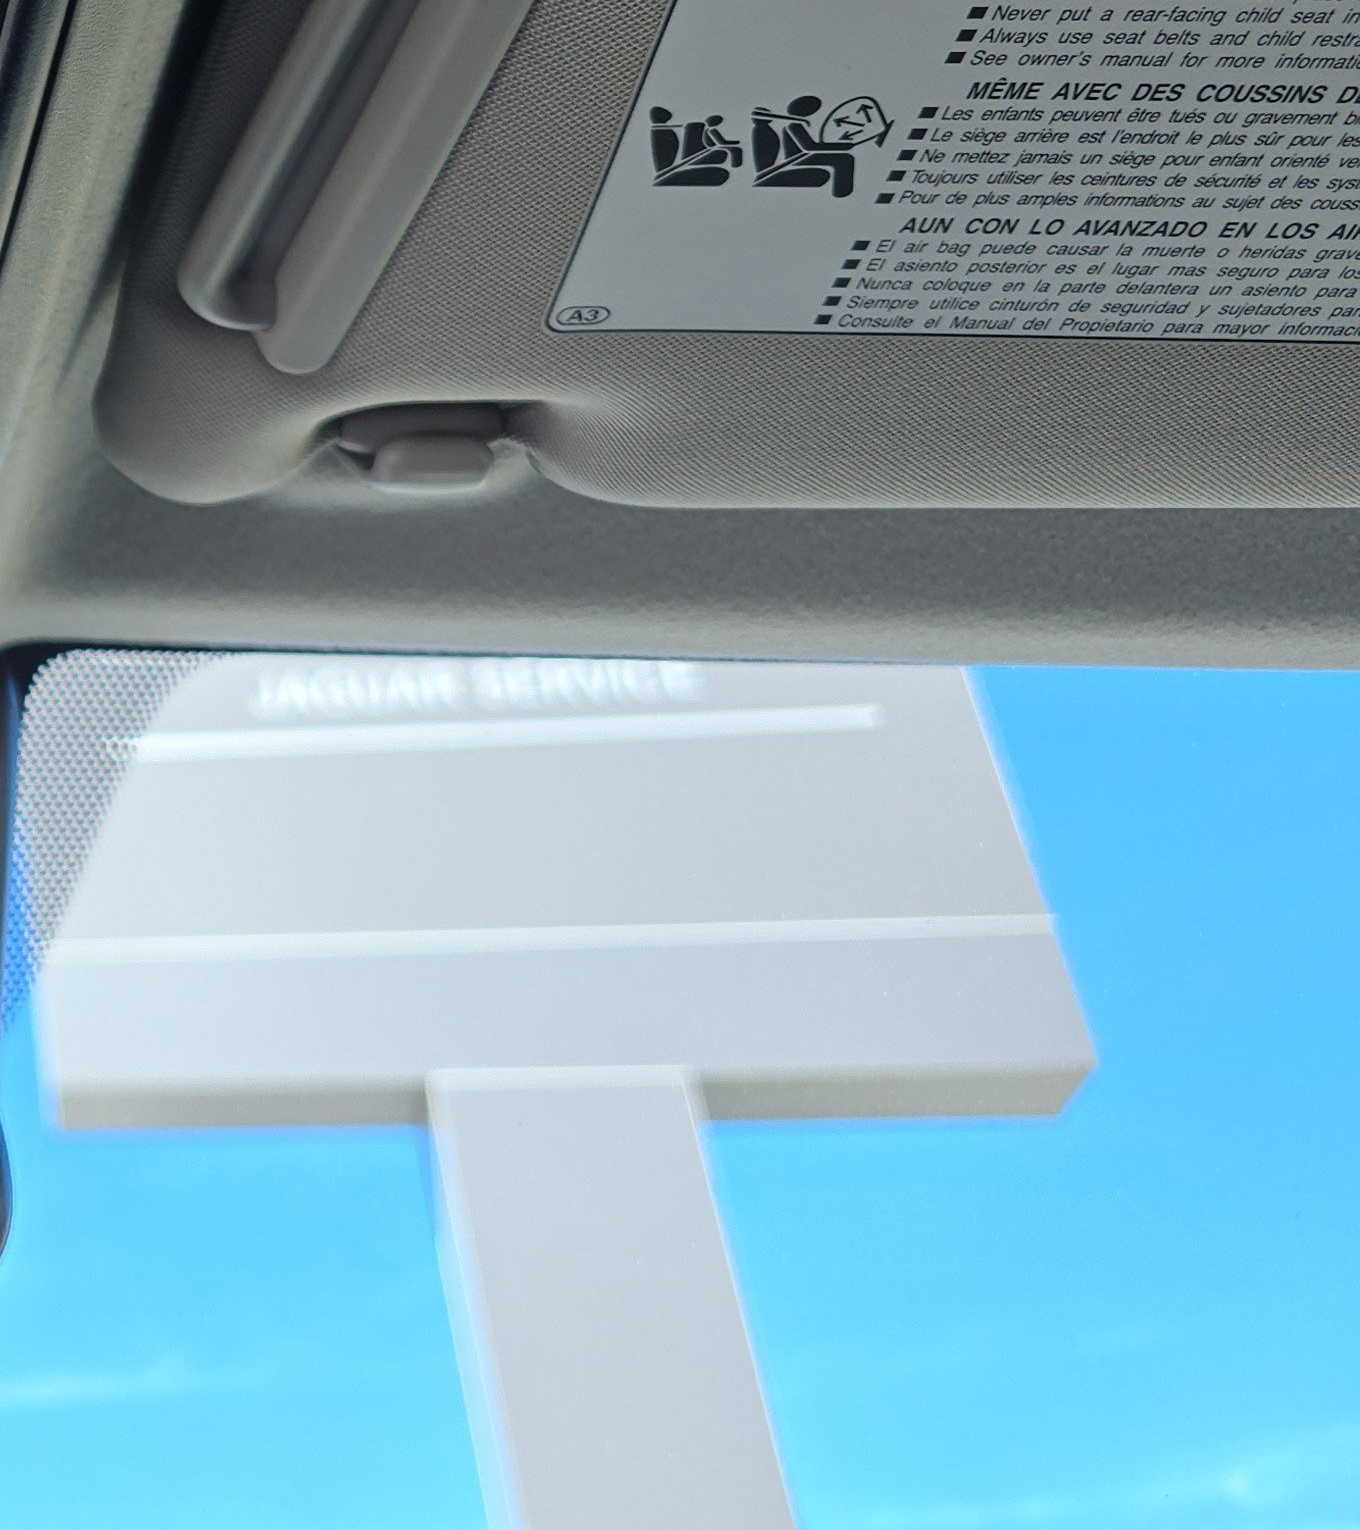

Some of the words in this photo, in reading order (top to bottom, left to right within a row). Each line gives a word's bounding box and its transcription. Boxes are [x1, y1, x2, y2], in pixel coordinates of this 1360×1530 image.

[992, 5, 1051, 21] Never
[1056, 7, 1092, 25] put
[1100, 10, 1113, 21] a
[1124, 6, 1227, 26] rear-facing
[1236, 8, 1283, 23] child
[1291, 9, 1335, 23] seat
[979, 28, 1048, 47] Always
[1058, 33, 1093, 44] use
[1103, 31, 1146, 44] seat
[1154, 30, 1200, 45] belts
[1210, 31, 1250, 45] and
[1257, 31, 1305, 46] child
[970, 50, 1007, 65] See
[1018, 51, 1092, 66] owner's
[1100, 52, 1173, 66] manual
[1180, 52, 1208, 67] for
[1215, 57, 1265, 68] more
[967, 78, 1044, 99] MÊME
[1052, 83, 1122, 101] AVEC
[1131, 84, 1185, 101] DES
[1197, 85, 1328, 103] COUSSINS
[942, 106, 974, 120] Les
[981, 106, 1044, 121] enfants
[1049, 109, 1122, 124] peuvent
[1127, 108, 1161, 122] être
[1169, 109, 1206, 123] tués
[1213, 112, 1238, 124] ou
[1242, 112, 1338, 127] gravement
[930, 128, 953, 142] Le
[1078, 131, 1106, 143] est
[1111, 130, 1180, 144] l'endroit
[1186, 131, 1203, 145] le
[1207, 131, 1247, 148] plus
[1287, 136, 1332, 149] pour
[912, 170, 979, 187] Toujours
[987, 171, 1043, 184] utiliser
[1049, 171, 1075, 185] les
[1081, 172, 1157, 186] ceintures
[1164, 173, 1187, 187] de
[1194, 173, 1262, 188] sécurité
[1268, 176, 1287, 188] et
[1293, 175, 1319, 189] les
[899, 218, 954, 233] AUN
[966, 218, 1020, 234] CON
[1028, 219, 1064, 235] LO
[1073, 220, 1207, 237] AVANZADO
[1218, 222, 1257, 238] EN
[1265, 223, 1319, 239] LOS
[567, 309, 600, 322] A3
